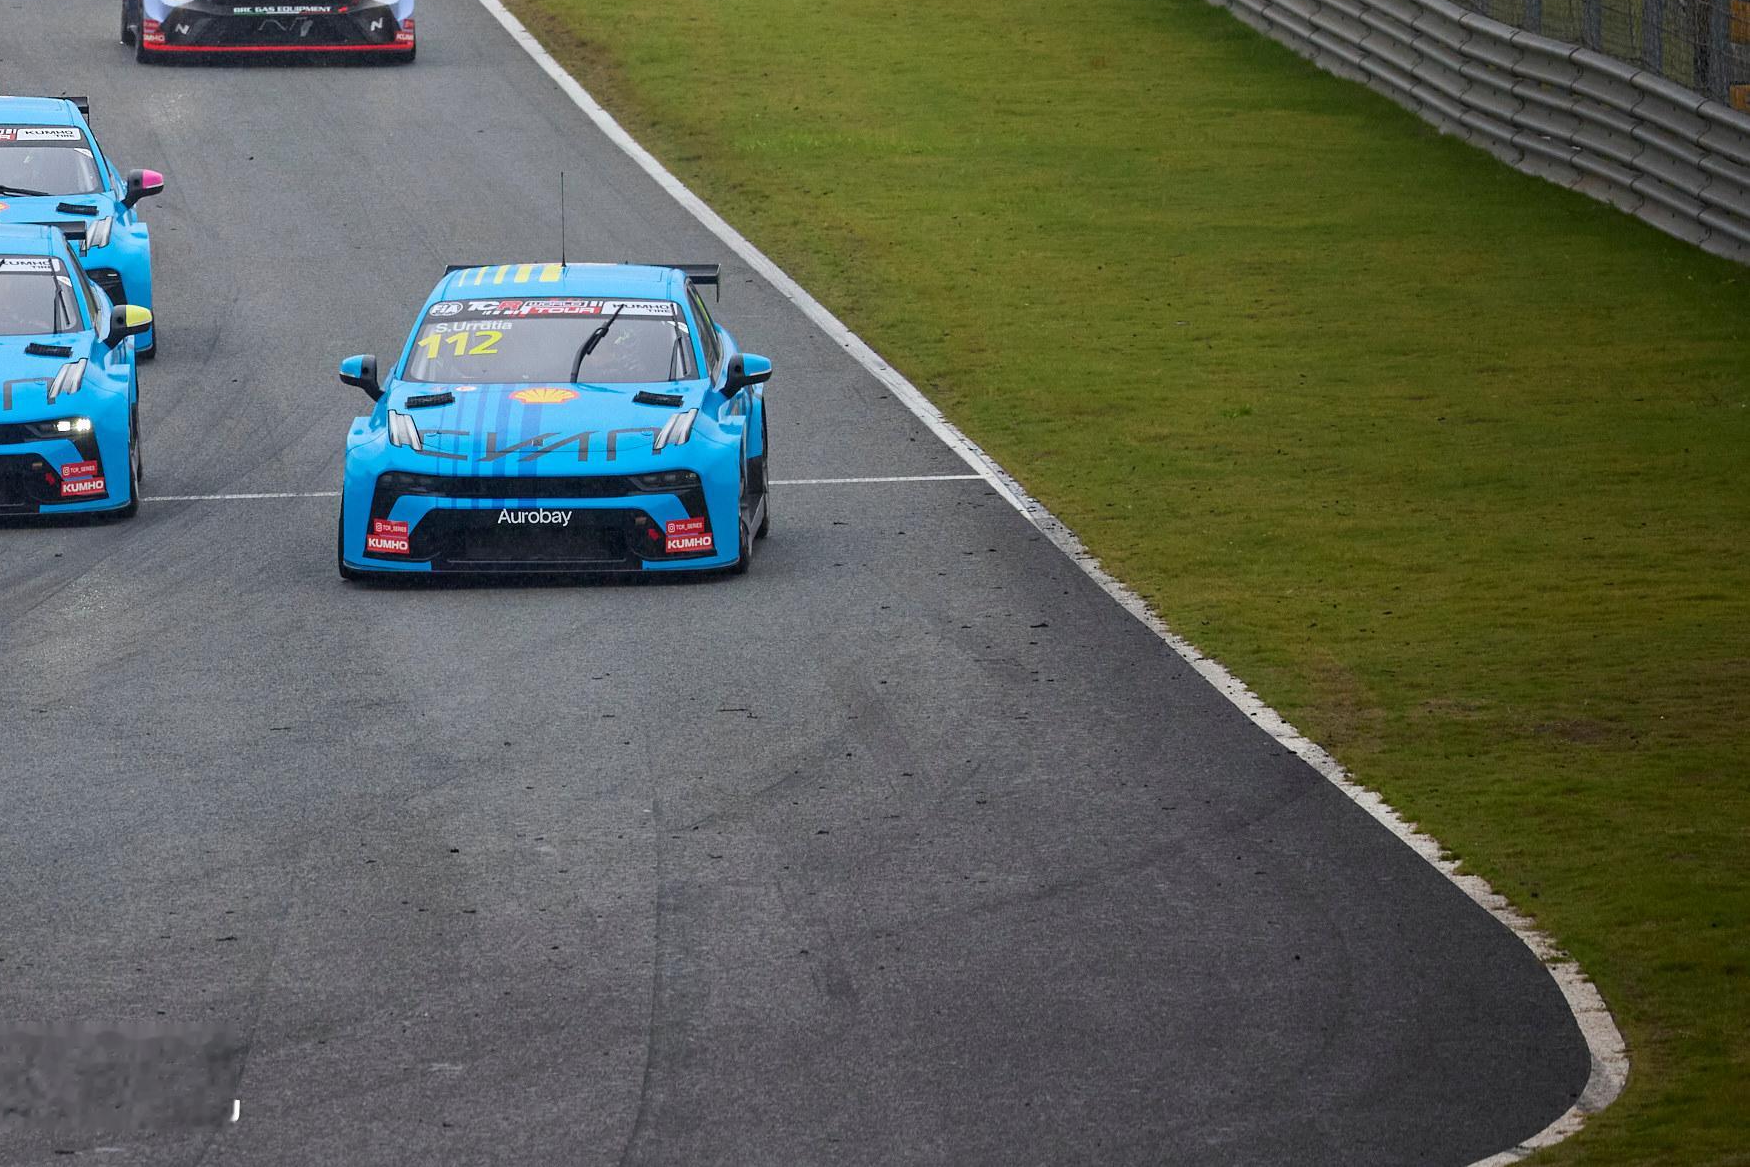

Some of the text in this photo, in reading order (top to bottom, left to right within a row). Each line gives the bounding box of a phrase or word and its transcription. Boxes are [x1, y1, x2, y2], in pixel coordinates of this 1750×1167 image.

[433, 301, 524, 315] FIA TCR
[533, 307, 596, 315] TOUR
[417, 330, 505, 360] 112
[62, 478, 104, 493] KUMHO
[497, 509, 573, 528] Aurobay
[368, 537, 409, 551] KUMHO
[668, 535, 712, 550] KUMHO
